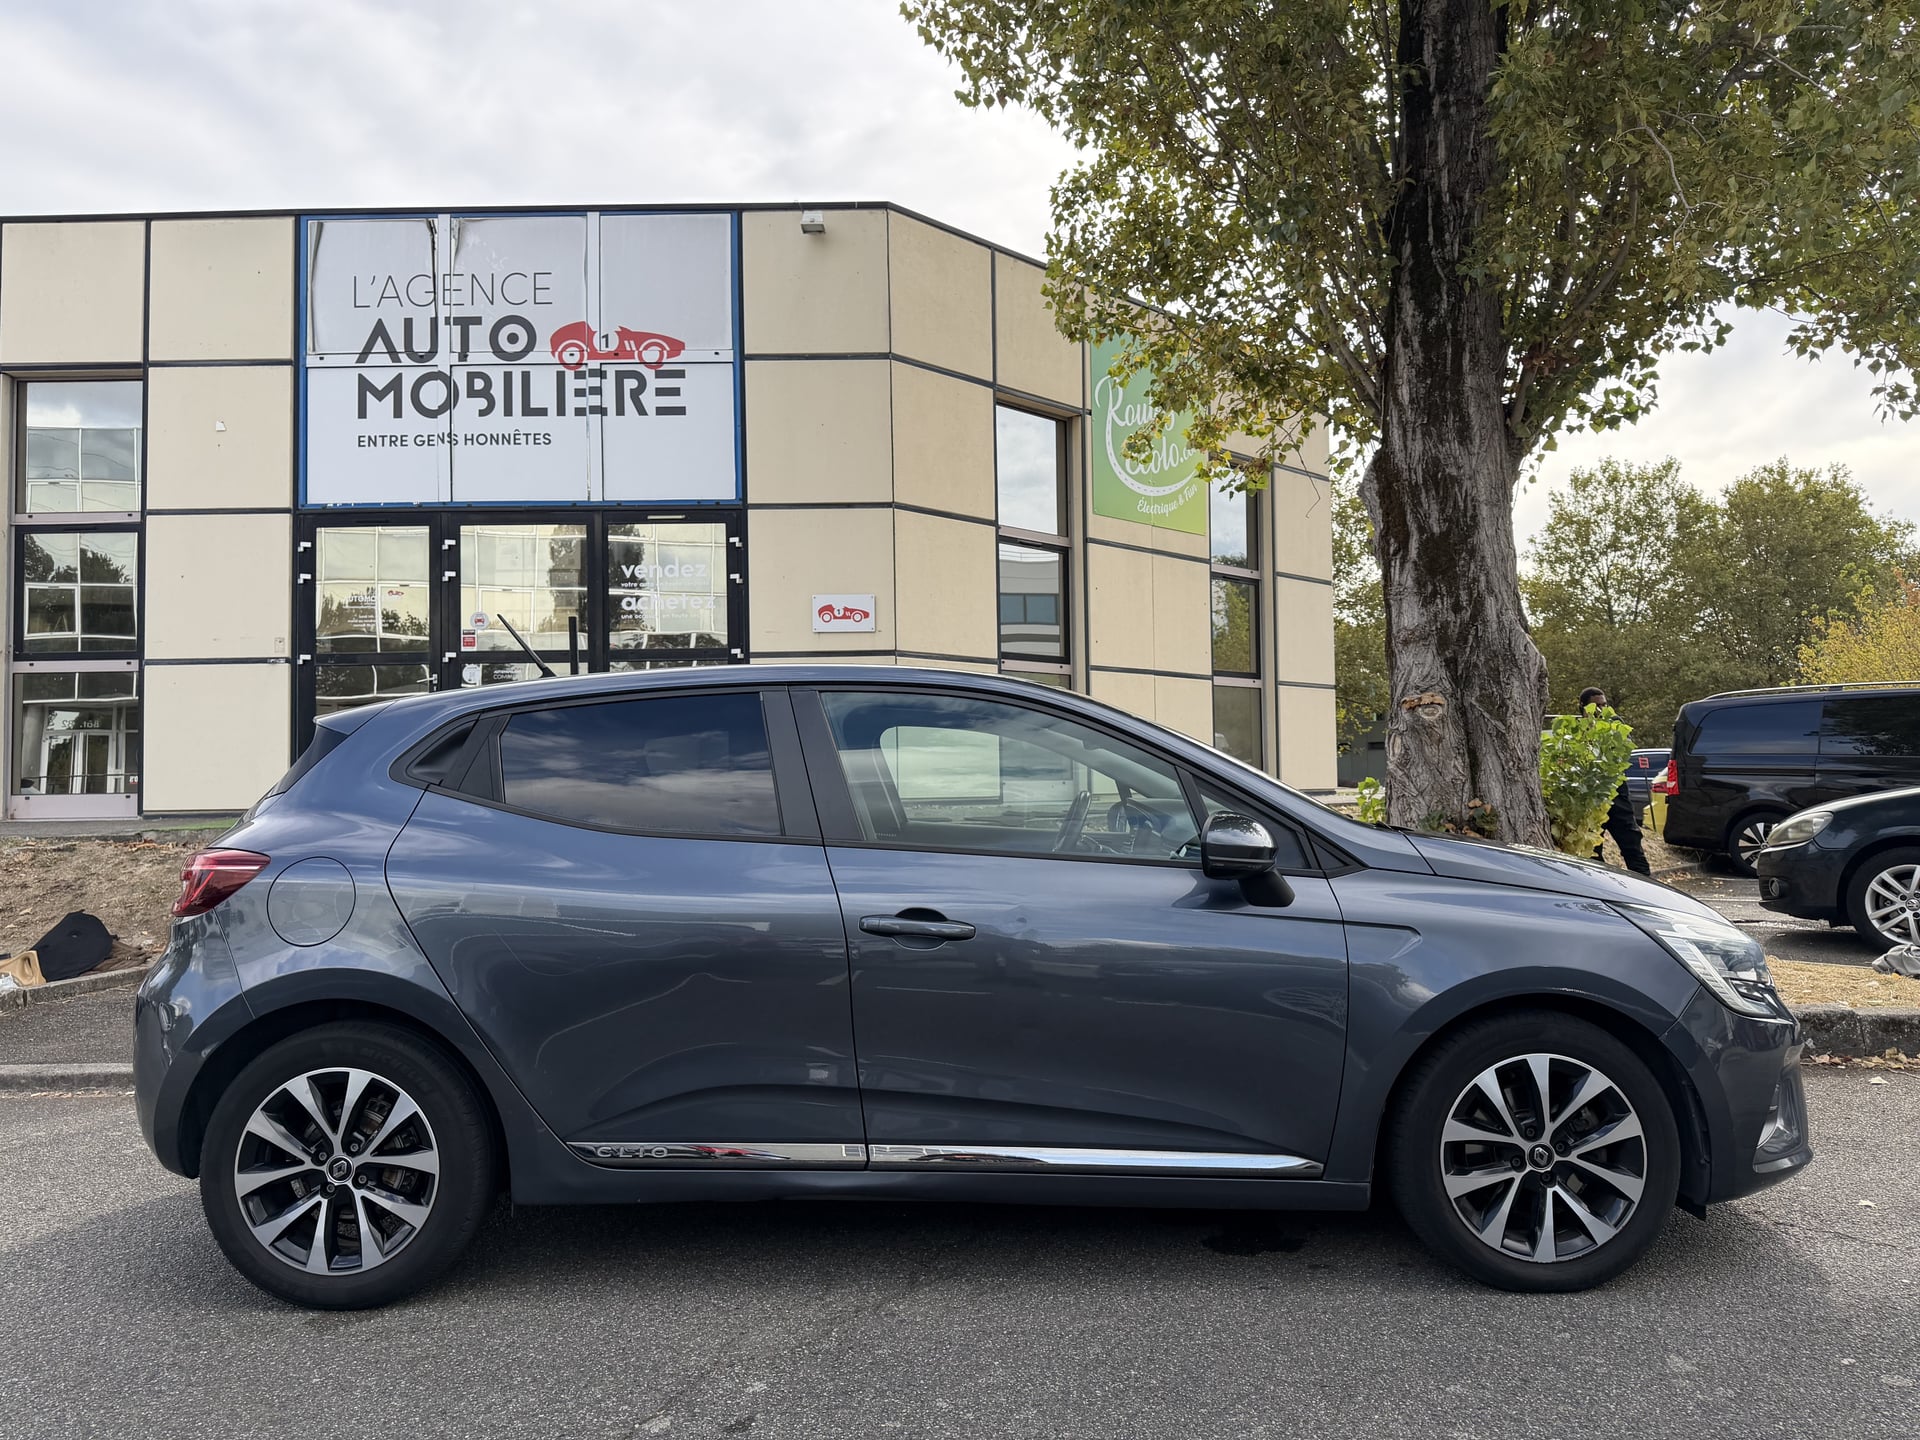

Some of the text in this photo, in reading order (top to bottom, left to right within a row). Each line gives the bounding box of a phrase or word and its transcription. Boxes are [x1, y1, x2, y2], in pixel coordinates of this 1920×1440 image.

[354, 272, 553, 308] L'AGENCE
[355, 314, 537, 364] AUTO
[357, 368, 687, 420] MOBILIERE
[357, 429, 552, 448] ENTRE GENS HONNÊTES
[621, 557, 707, 579] vendez
[621, 589, 717, 611] achetez
[597, 1146, 668, 1158] CLIO
